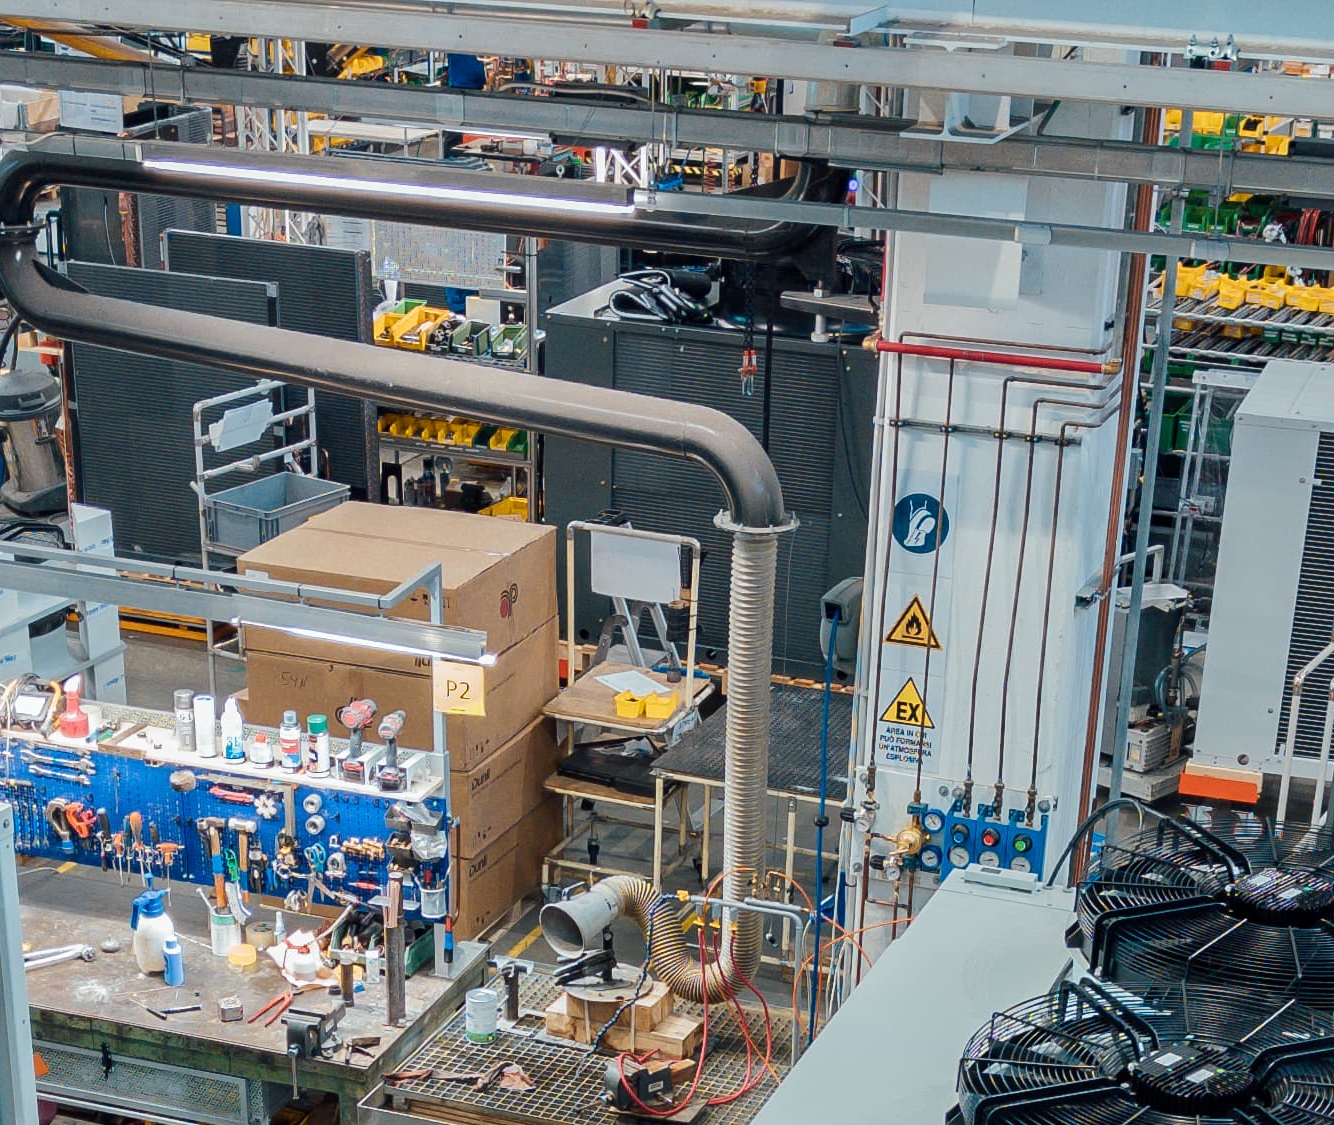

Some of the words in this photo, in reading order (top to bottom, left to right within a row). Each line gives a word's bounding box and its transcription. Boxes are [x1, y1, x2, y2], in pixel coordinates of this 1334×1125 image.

[446, 679, 471, 700] P2
[895, 700, 920, 722] EX
[885, 726, 905, 737] AREA
[906, 729, 914, 737] IN
[878, 744, 932, 757] UN'ATMOSFRA
